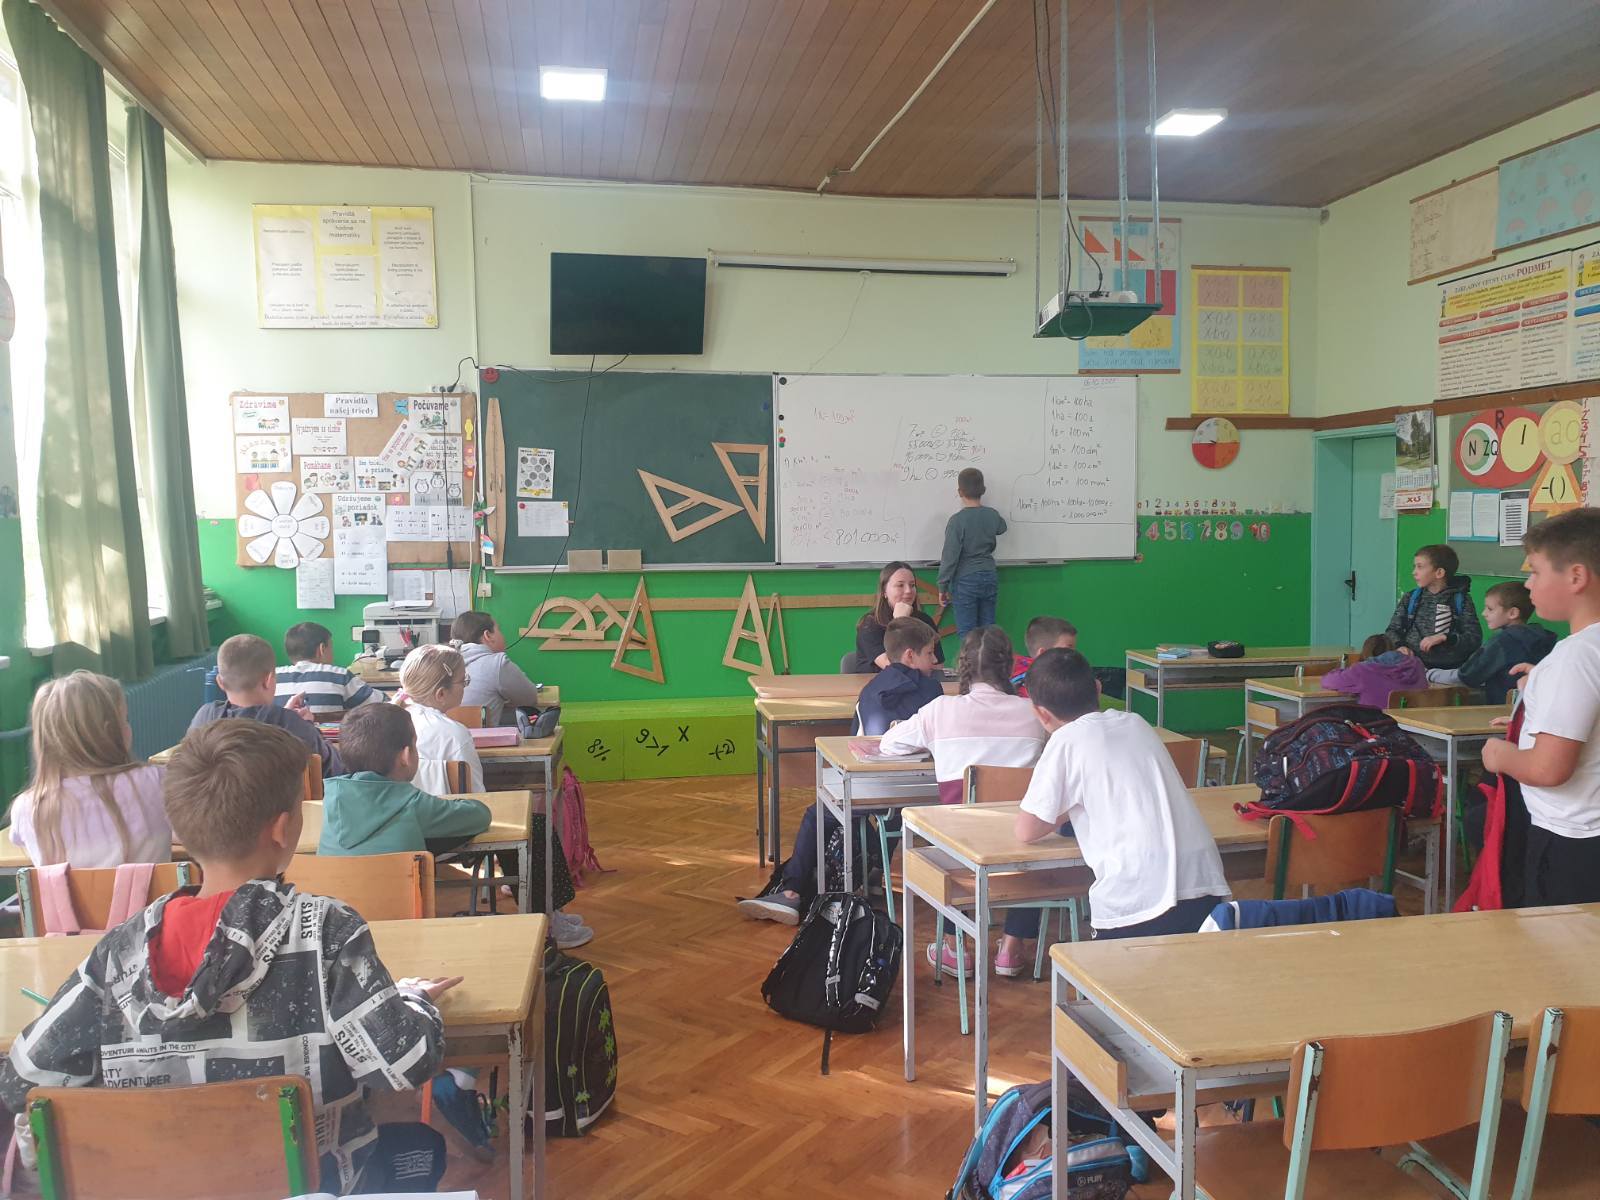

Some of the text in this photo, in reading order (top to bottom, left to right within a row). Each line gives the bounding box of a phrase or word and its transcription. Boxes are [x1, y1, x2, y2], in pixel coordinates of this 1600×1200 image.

[1516, 260, 1553, 277] PODMET
[1495, 410, 1505, 429] R
[1468, 440, 1477, 457] N
[181, 1043, 197, 1051] CITY
